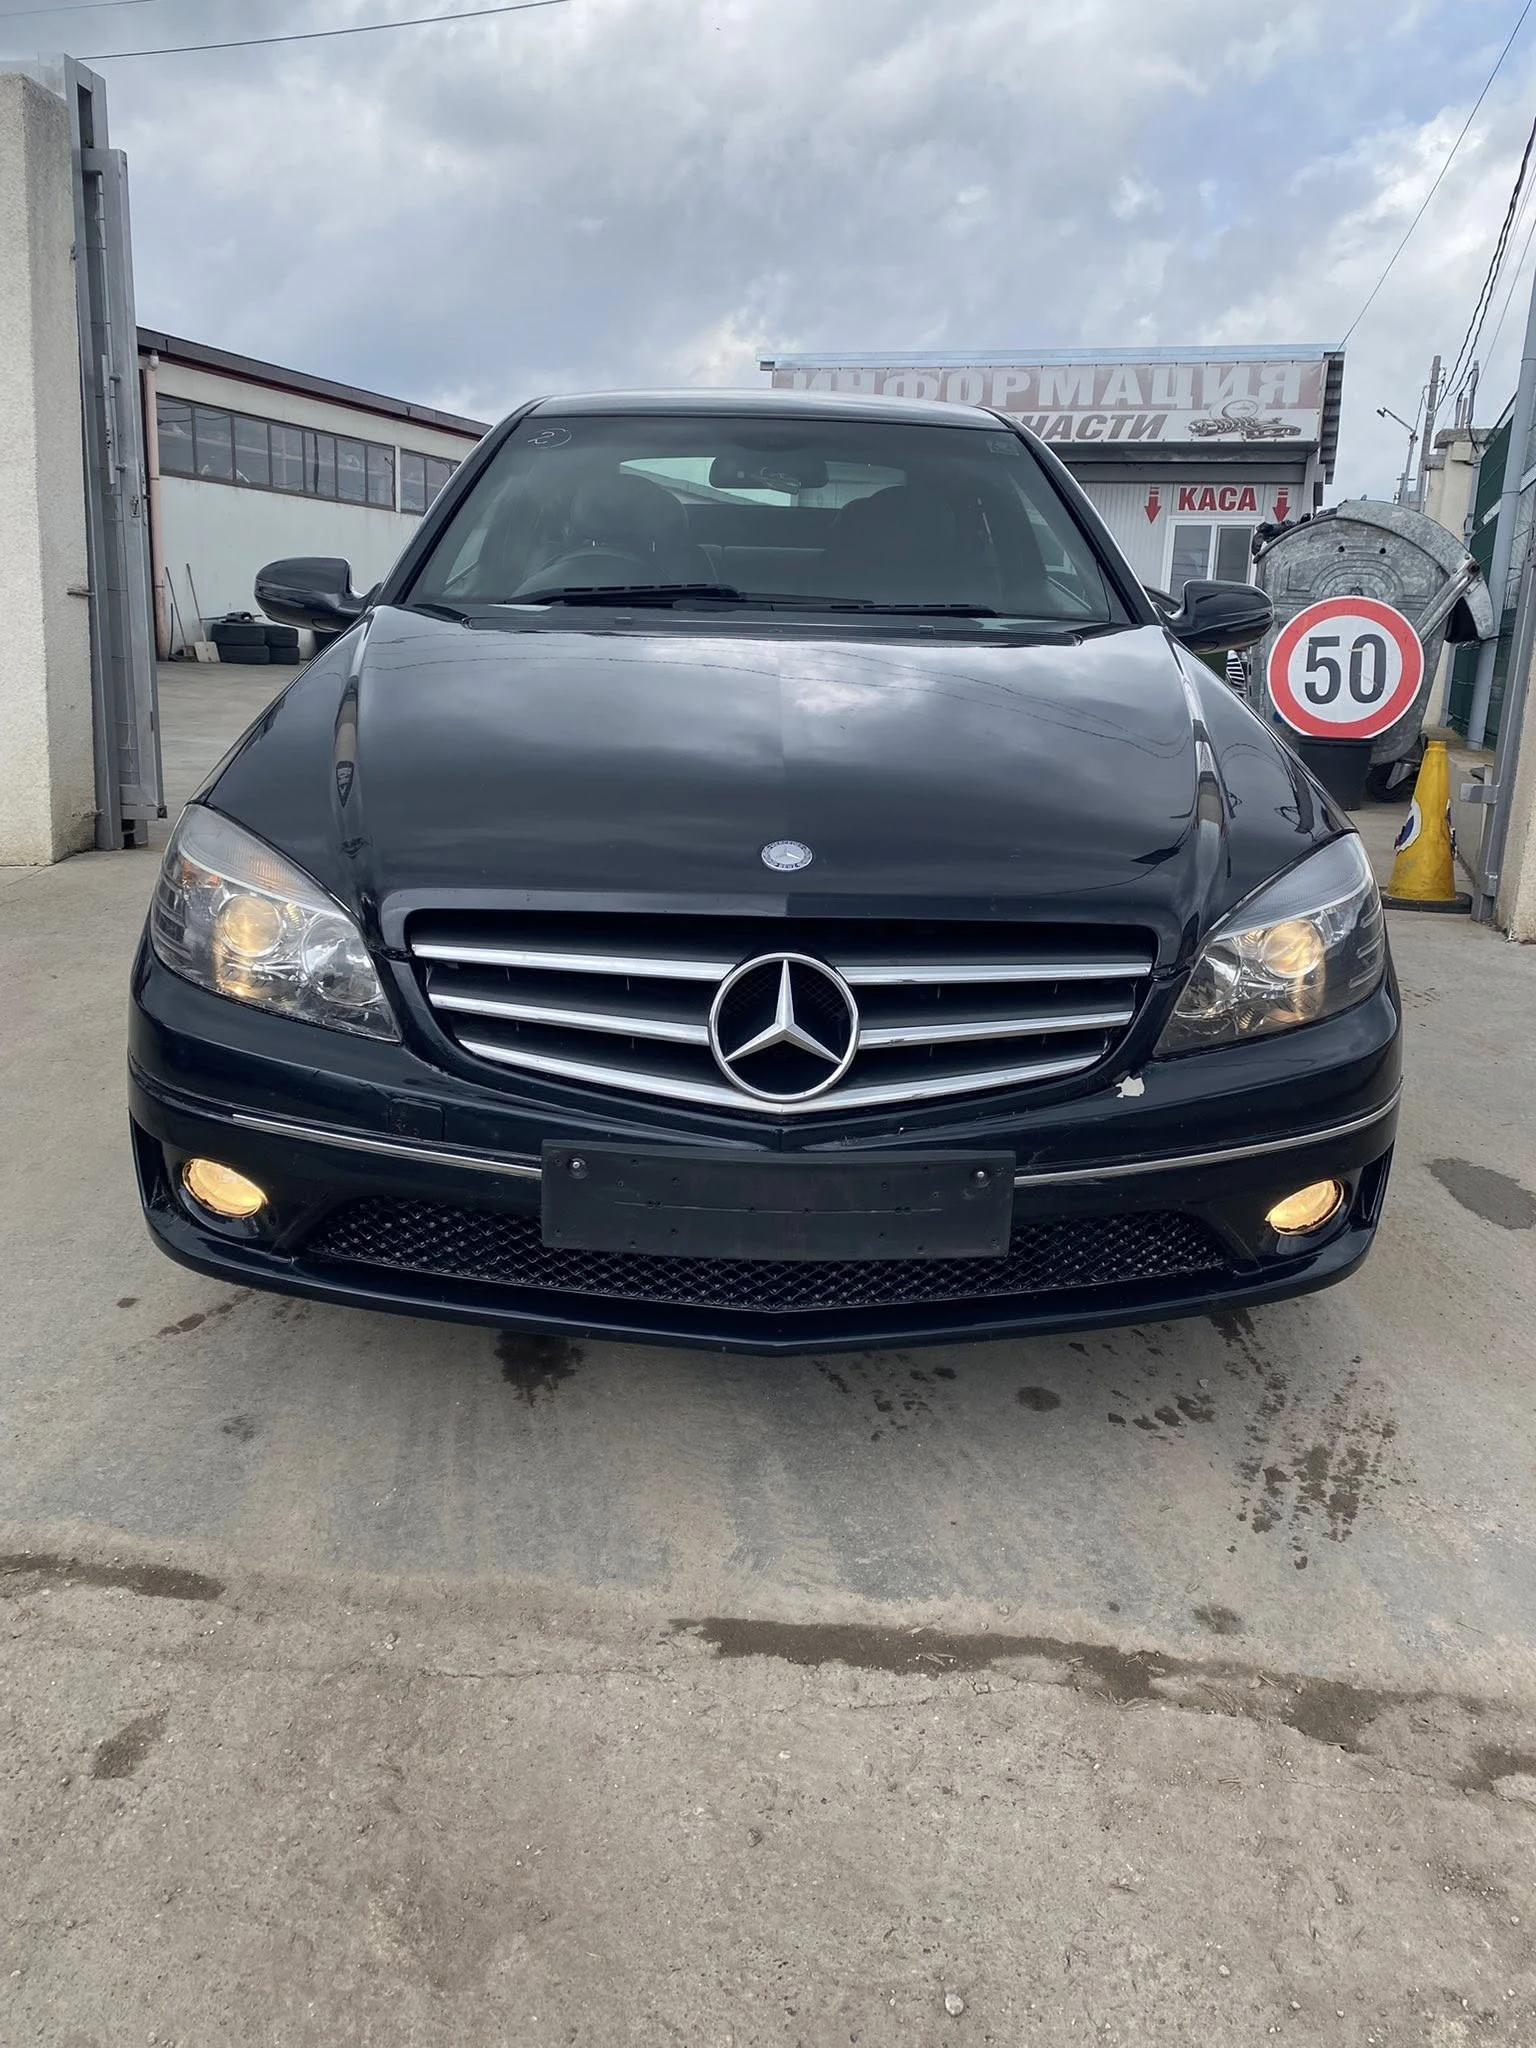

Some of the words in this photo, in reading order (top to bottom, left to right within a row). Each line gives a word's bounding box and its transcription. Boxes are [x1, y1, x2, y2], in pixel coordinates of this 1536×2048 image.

[793, 365, 1301, 409] ИНФОРМАЦИЯ
[1014, 414, 1168, 440] ЧАСТИ
[1178, 487, 1257, 511] КАСА
[1304, 633, 1387, 705] 50
